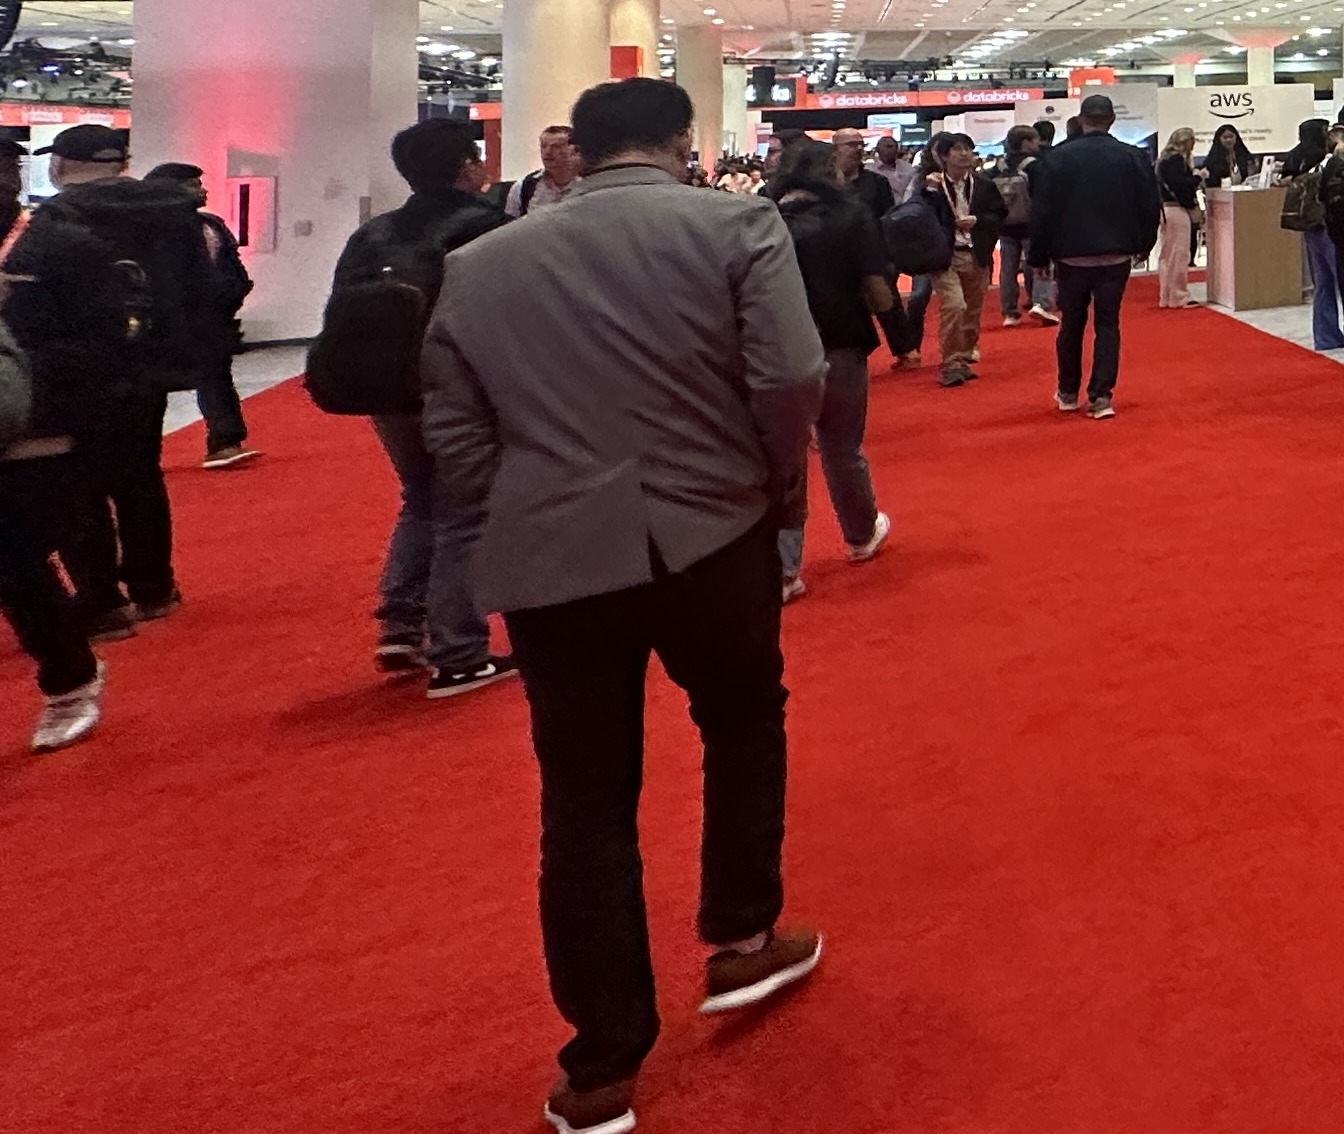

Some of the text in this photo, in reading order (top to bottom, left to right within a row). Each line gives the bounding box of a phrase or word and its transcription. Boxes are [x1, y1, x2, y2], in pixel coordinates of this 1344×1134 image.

[836, 94, 907, 106] databricks
[963, 90, 1030, 102] databricks
[1210, 92, 1253, 108] aws
